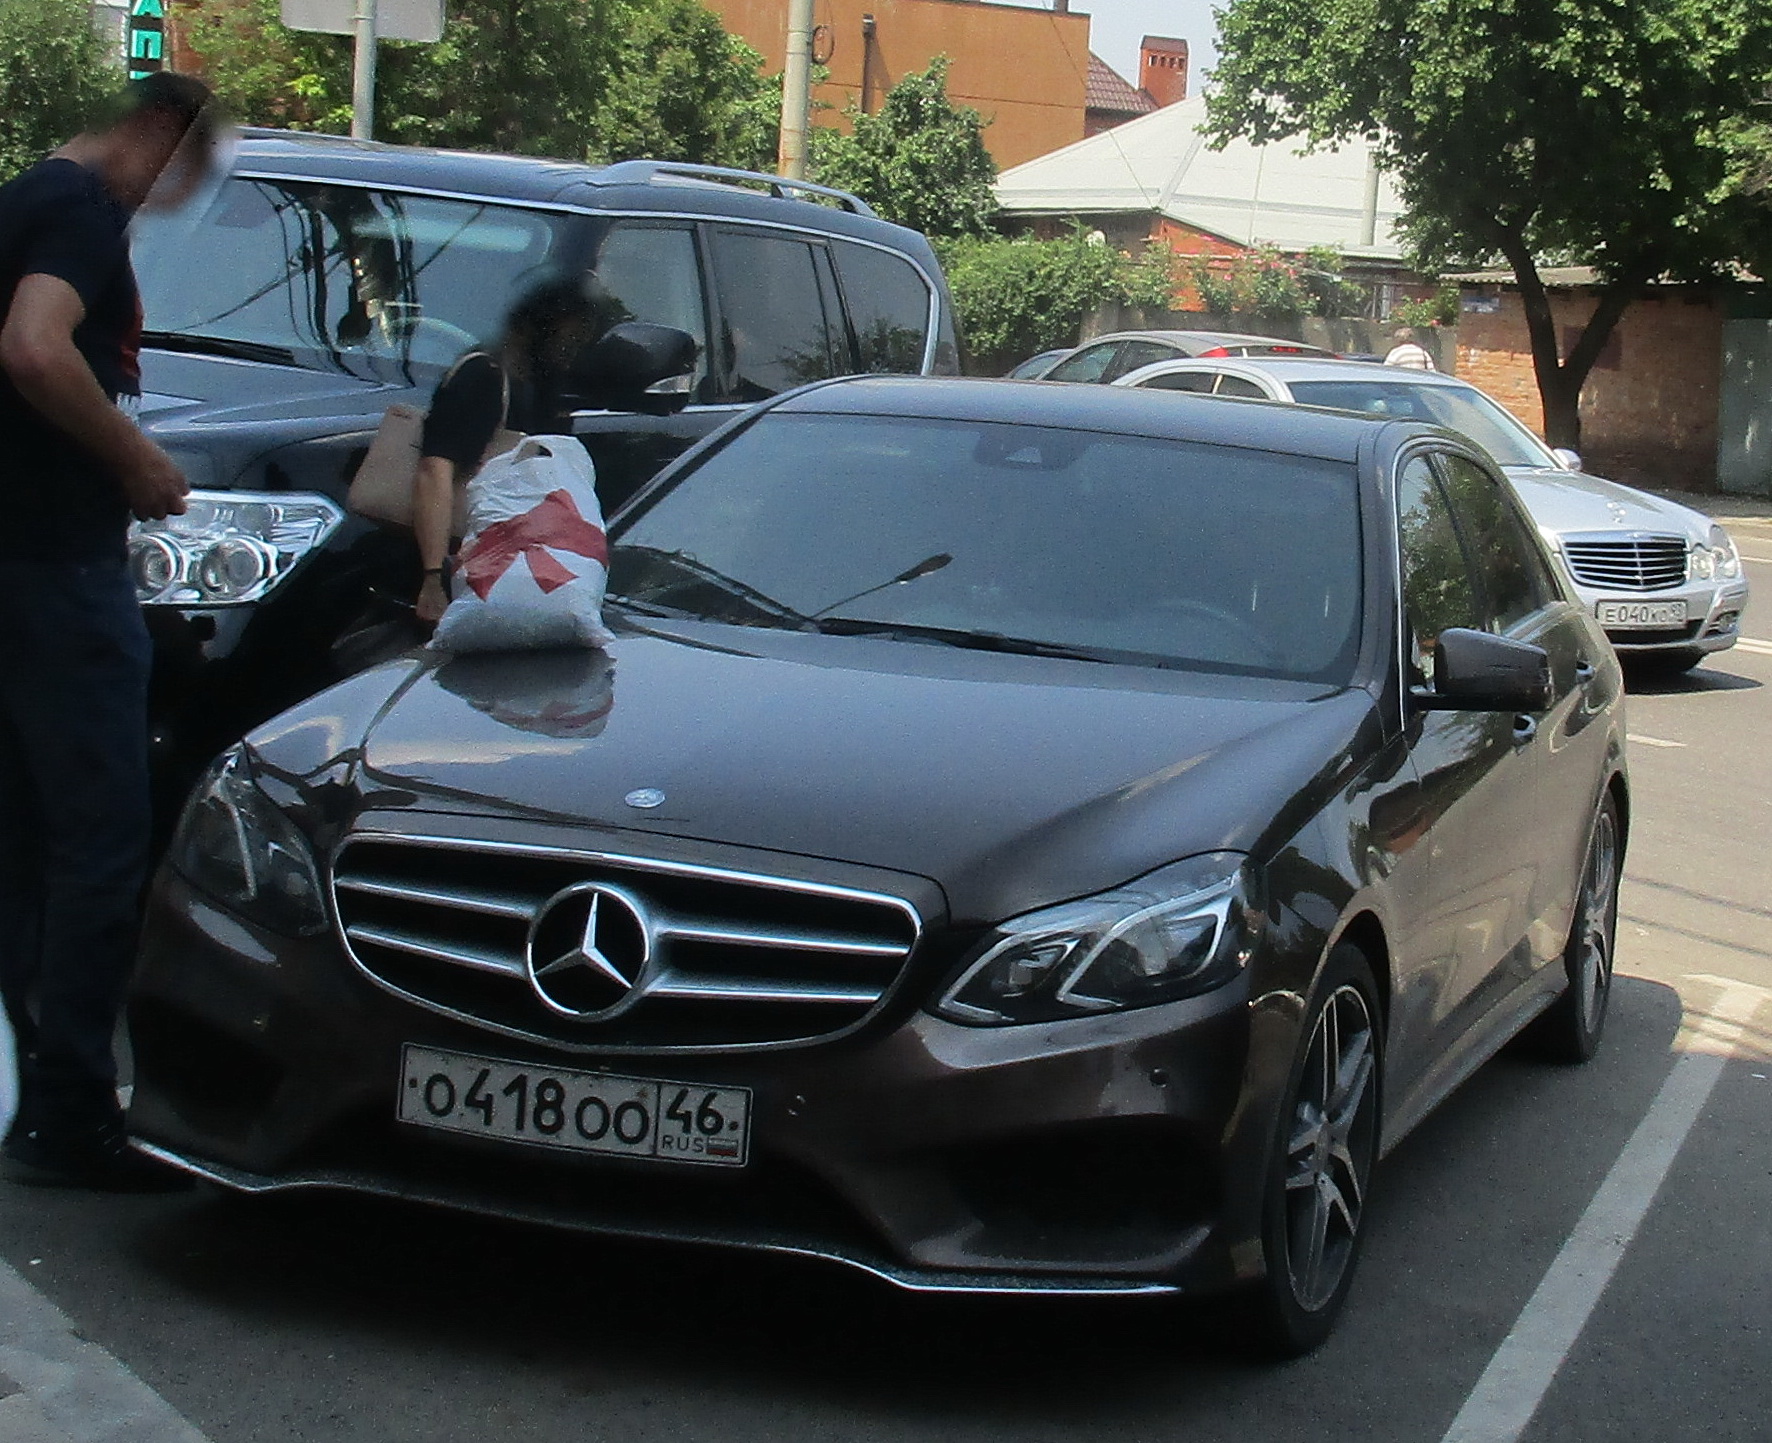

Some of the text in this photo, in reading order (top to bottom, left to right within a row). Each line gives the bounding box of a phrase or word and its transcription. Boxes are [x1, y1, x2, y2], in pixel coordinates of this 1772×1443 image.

[130, 0, 164, 80] АП
[424, 1068, 724, 1144] О418ОО 46
[662, 1134, 704, 1152] RUS
